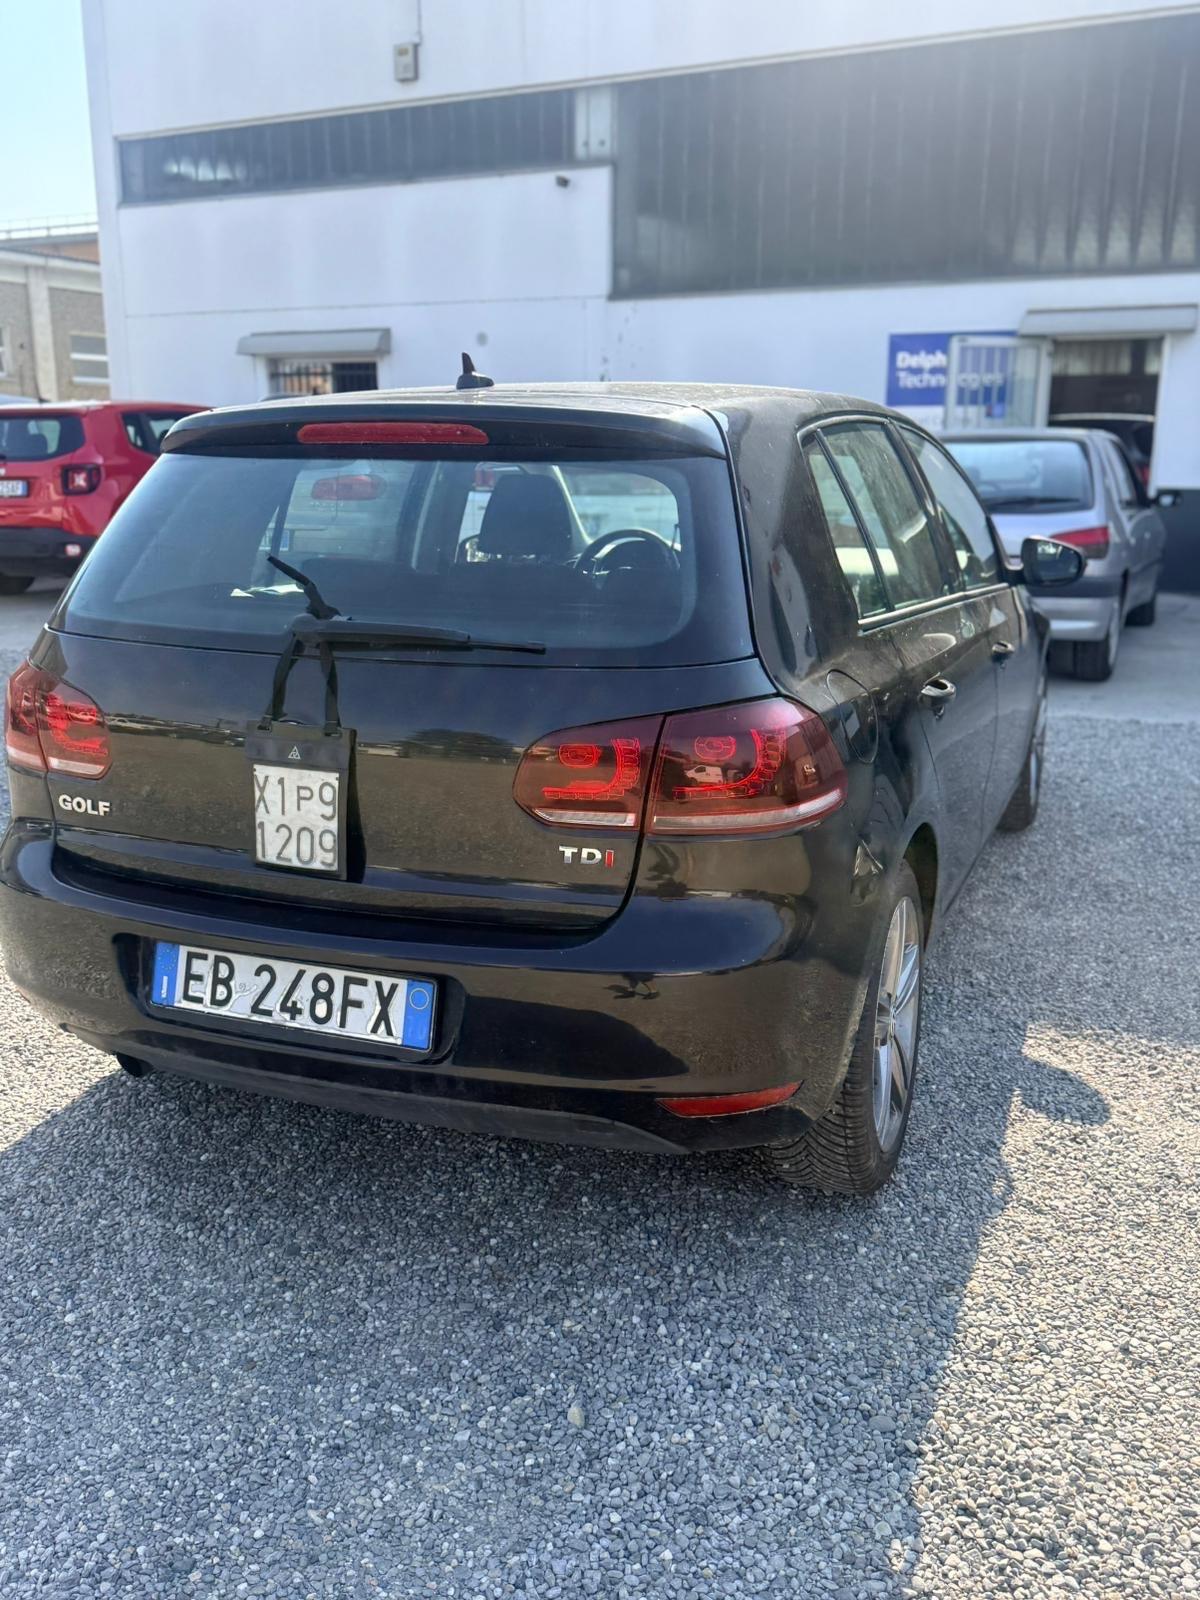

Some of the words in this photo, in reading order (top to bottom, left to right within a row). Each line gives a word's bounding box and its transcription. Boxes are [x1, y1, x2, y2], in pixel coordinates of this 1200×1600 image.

[896, 350, 948, 370] Delph
[58, 794, 110, 816] GOLF
[254, 774, 337, 821] X1P9
[257, 821, 337, 867] 1209
[559, 845, 614, 868] TDI
[182, 950, 235, 1007] EB
